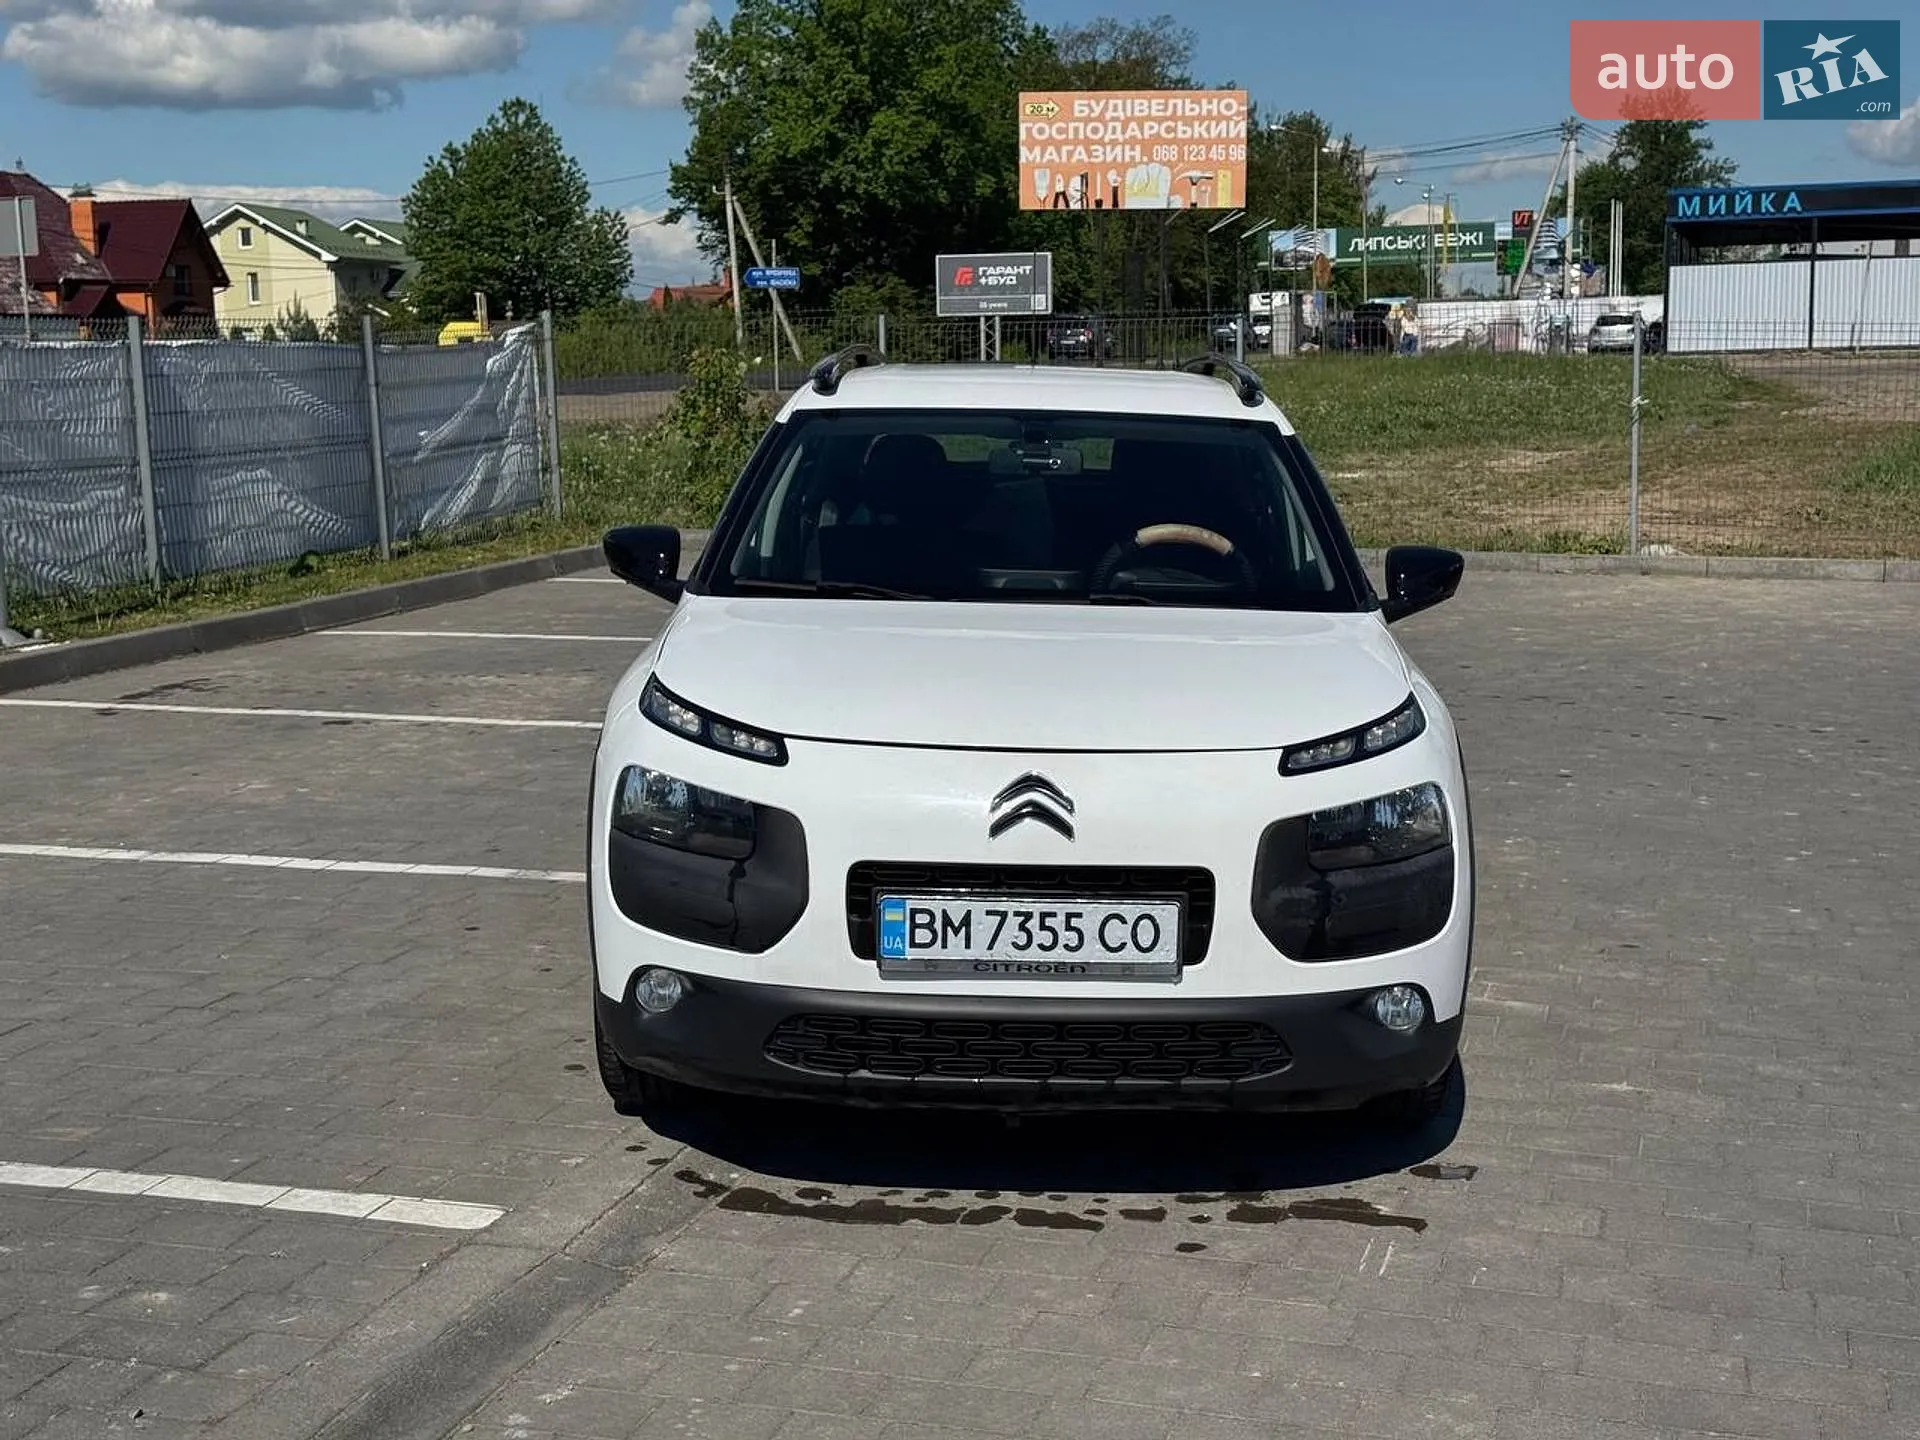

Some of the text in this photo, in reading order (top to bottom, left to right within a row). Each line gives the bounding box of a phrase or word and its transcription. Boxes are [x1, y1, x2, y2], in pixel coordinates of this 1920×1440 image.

[1030, 104, 1044, 114] 20
[1073, 99, 1247, 120] БУДІВЕЛЬНО-
[1020, 117, 1247, 142] ГОСПОДАРСЬКИЙ
[1020, 145, 1148, 163] МАГАЗИН.
[1153, 144, 1179, 161] 068
[1183, 144, 1206, 161] 123
[1208, 144, 1226, 161] 45
[1677, 190, 1803, 217] МИЙКА
[979, 265, 1033, 276] ГАРАНТ
[908, 907, 1161, 954] BM 7355 CO
[884, 938, 903, 950] UA
